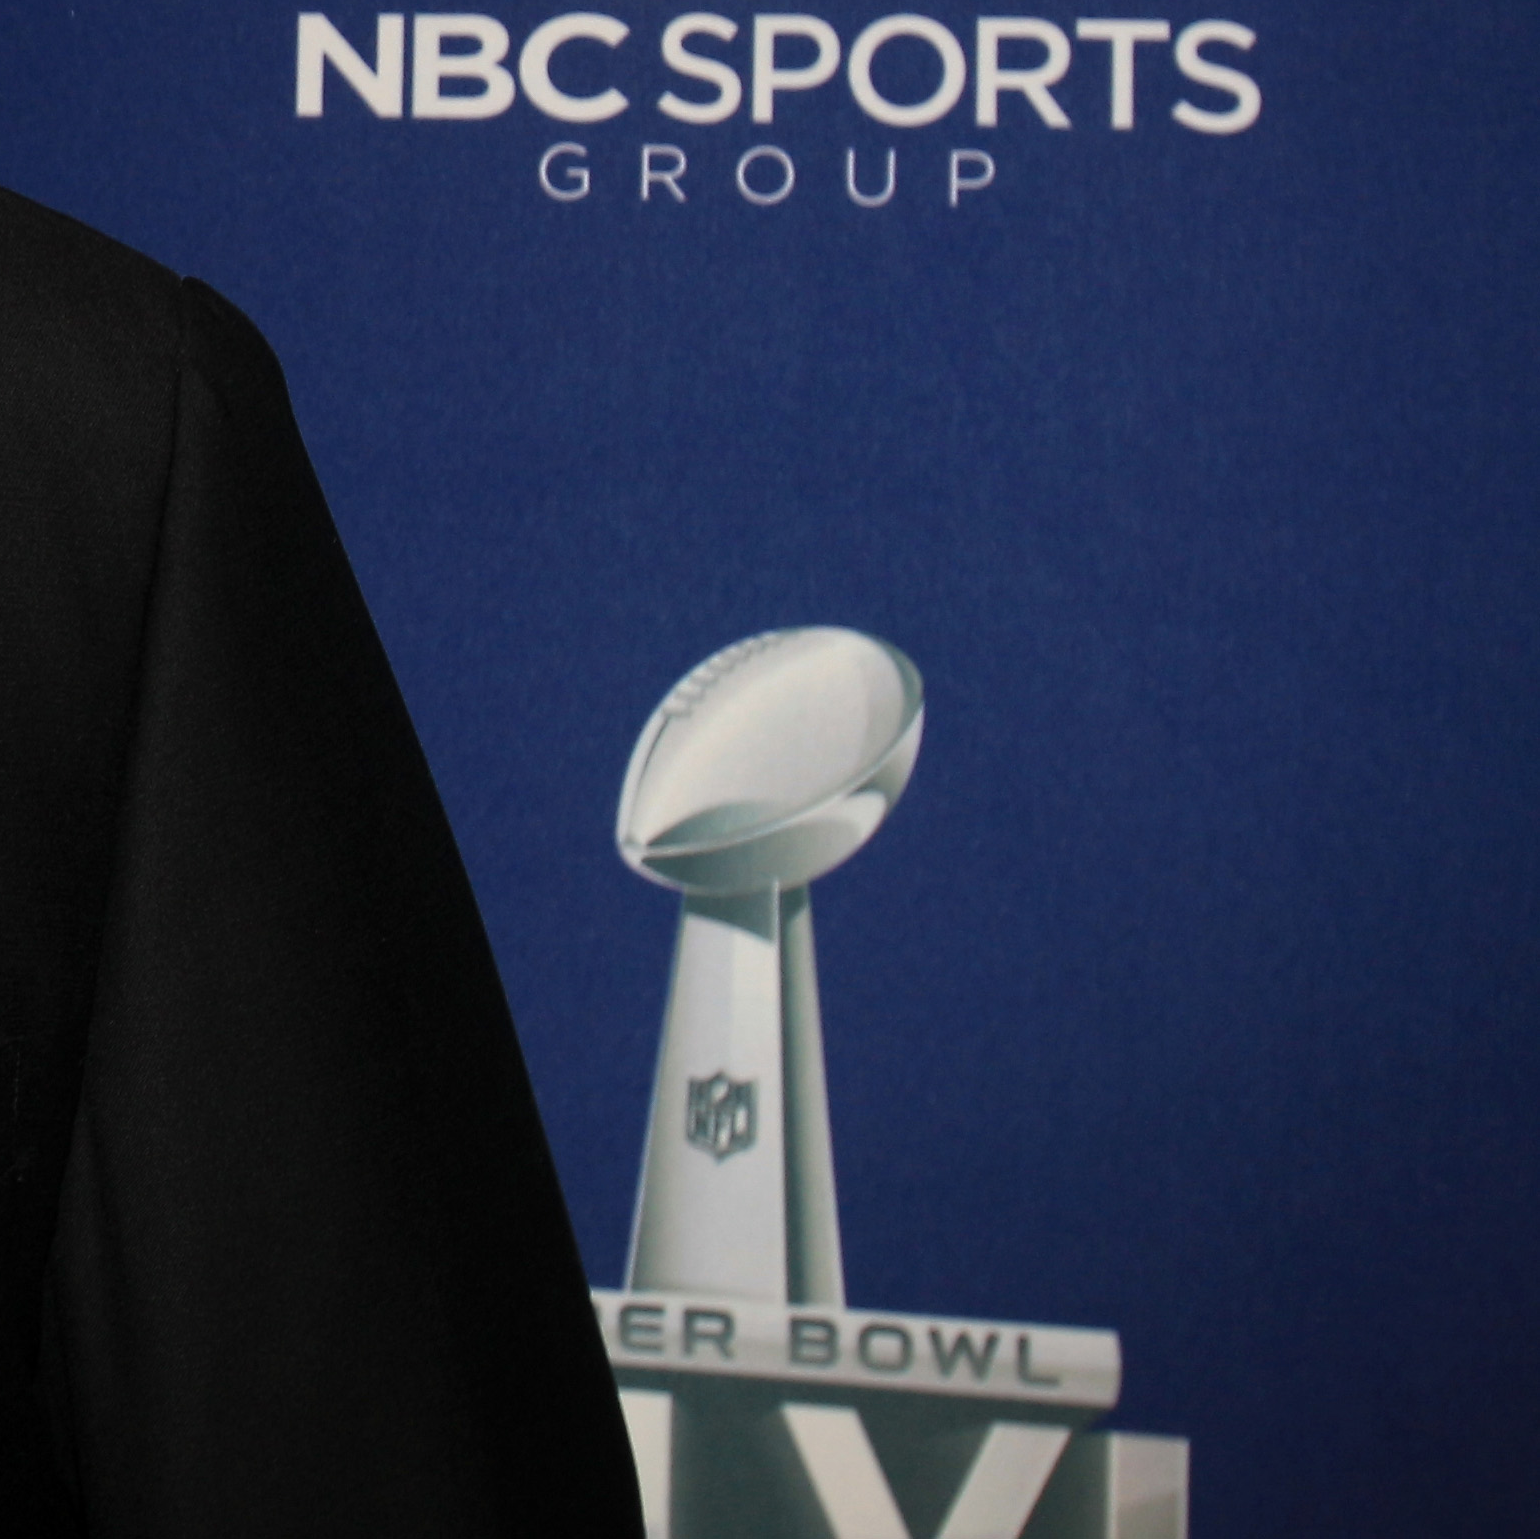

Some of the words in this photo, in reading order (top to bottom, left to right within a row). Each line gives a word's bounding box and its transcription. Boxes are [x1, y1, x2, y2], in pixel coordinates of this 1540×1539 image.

[295, 12, 629, 120] NBC
[656, 12, 1262, 134] SPORTS
[538, 142, 996, 207] GROUP
[788, 1317, 1061, 1388] BOWL
